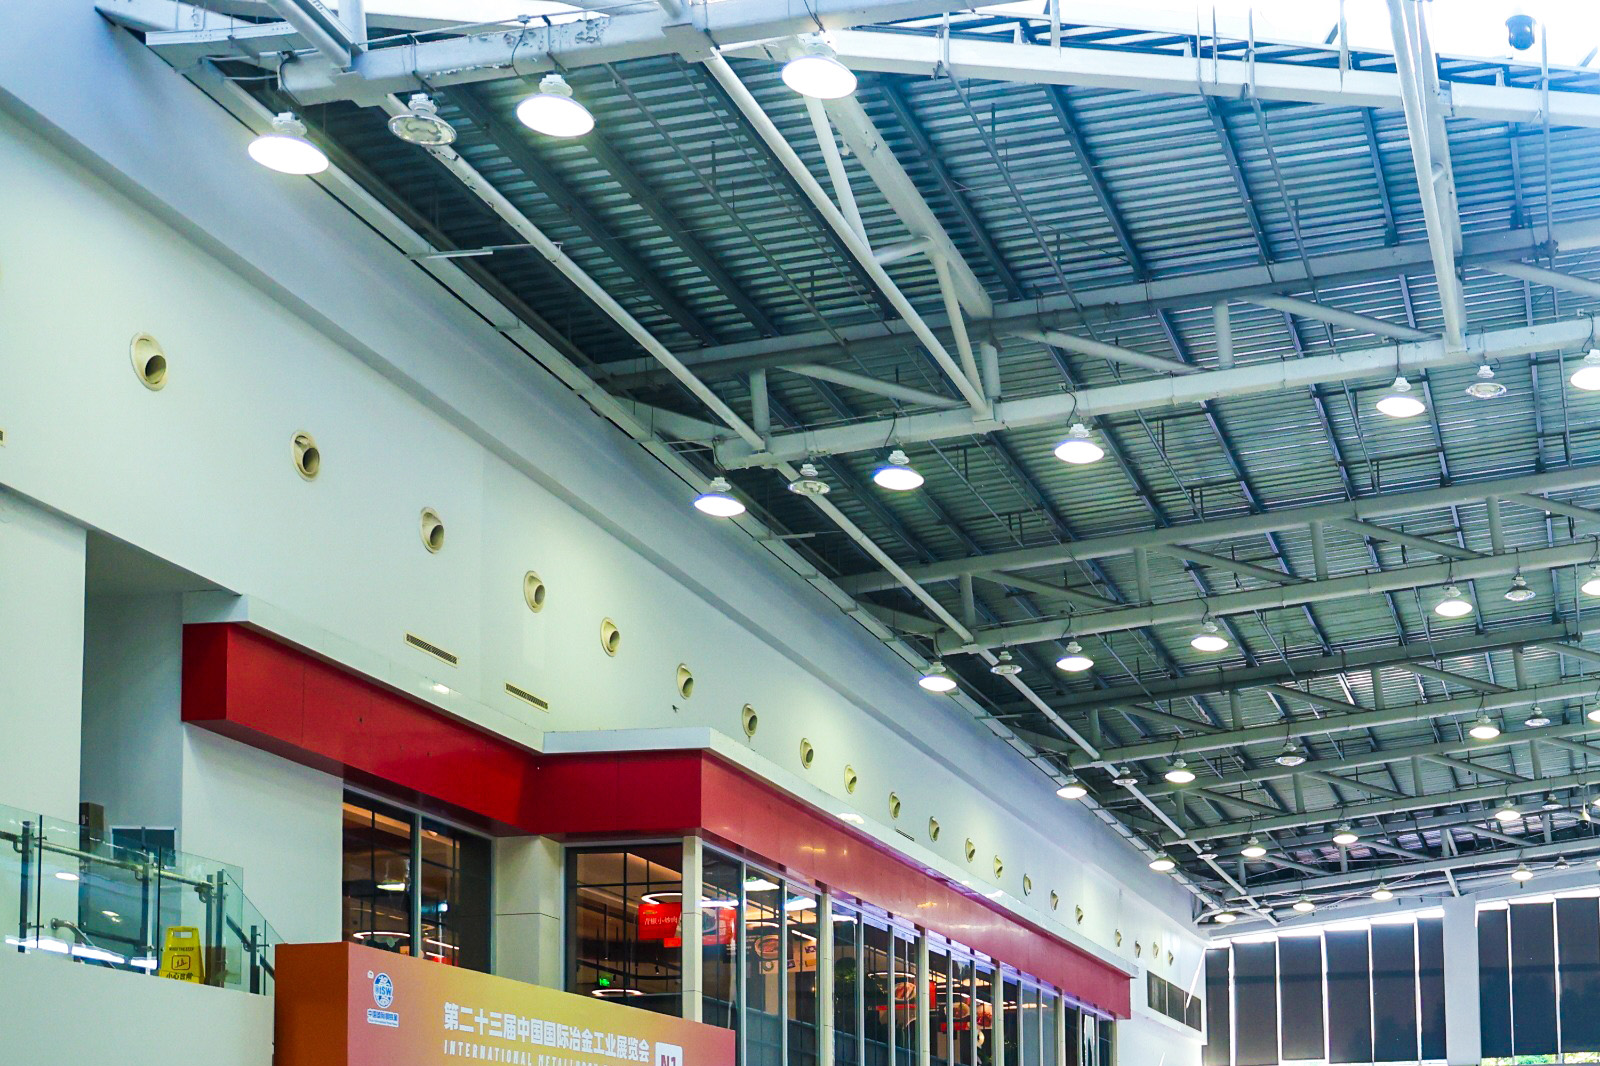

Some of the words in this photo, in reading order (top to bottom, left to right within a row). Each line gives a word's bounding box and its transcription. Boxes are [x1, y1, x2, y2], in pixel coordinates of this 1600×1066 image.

[444, 1002, 650, 1063] 第二十三届中国国际冶金工业展览会
[444, 1039, 532, 1066] INTERNATIONAL
